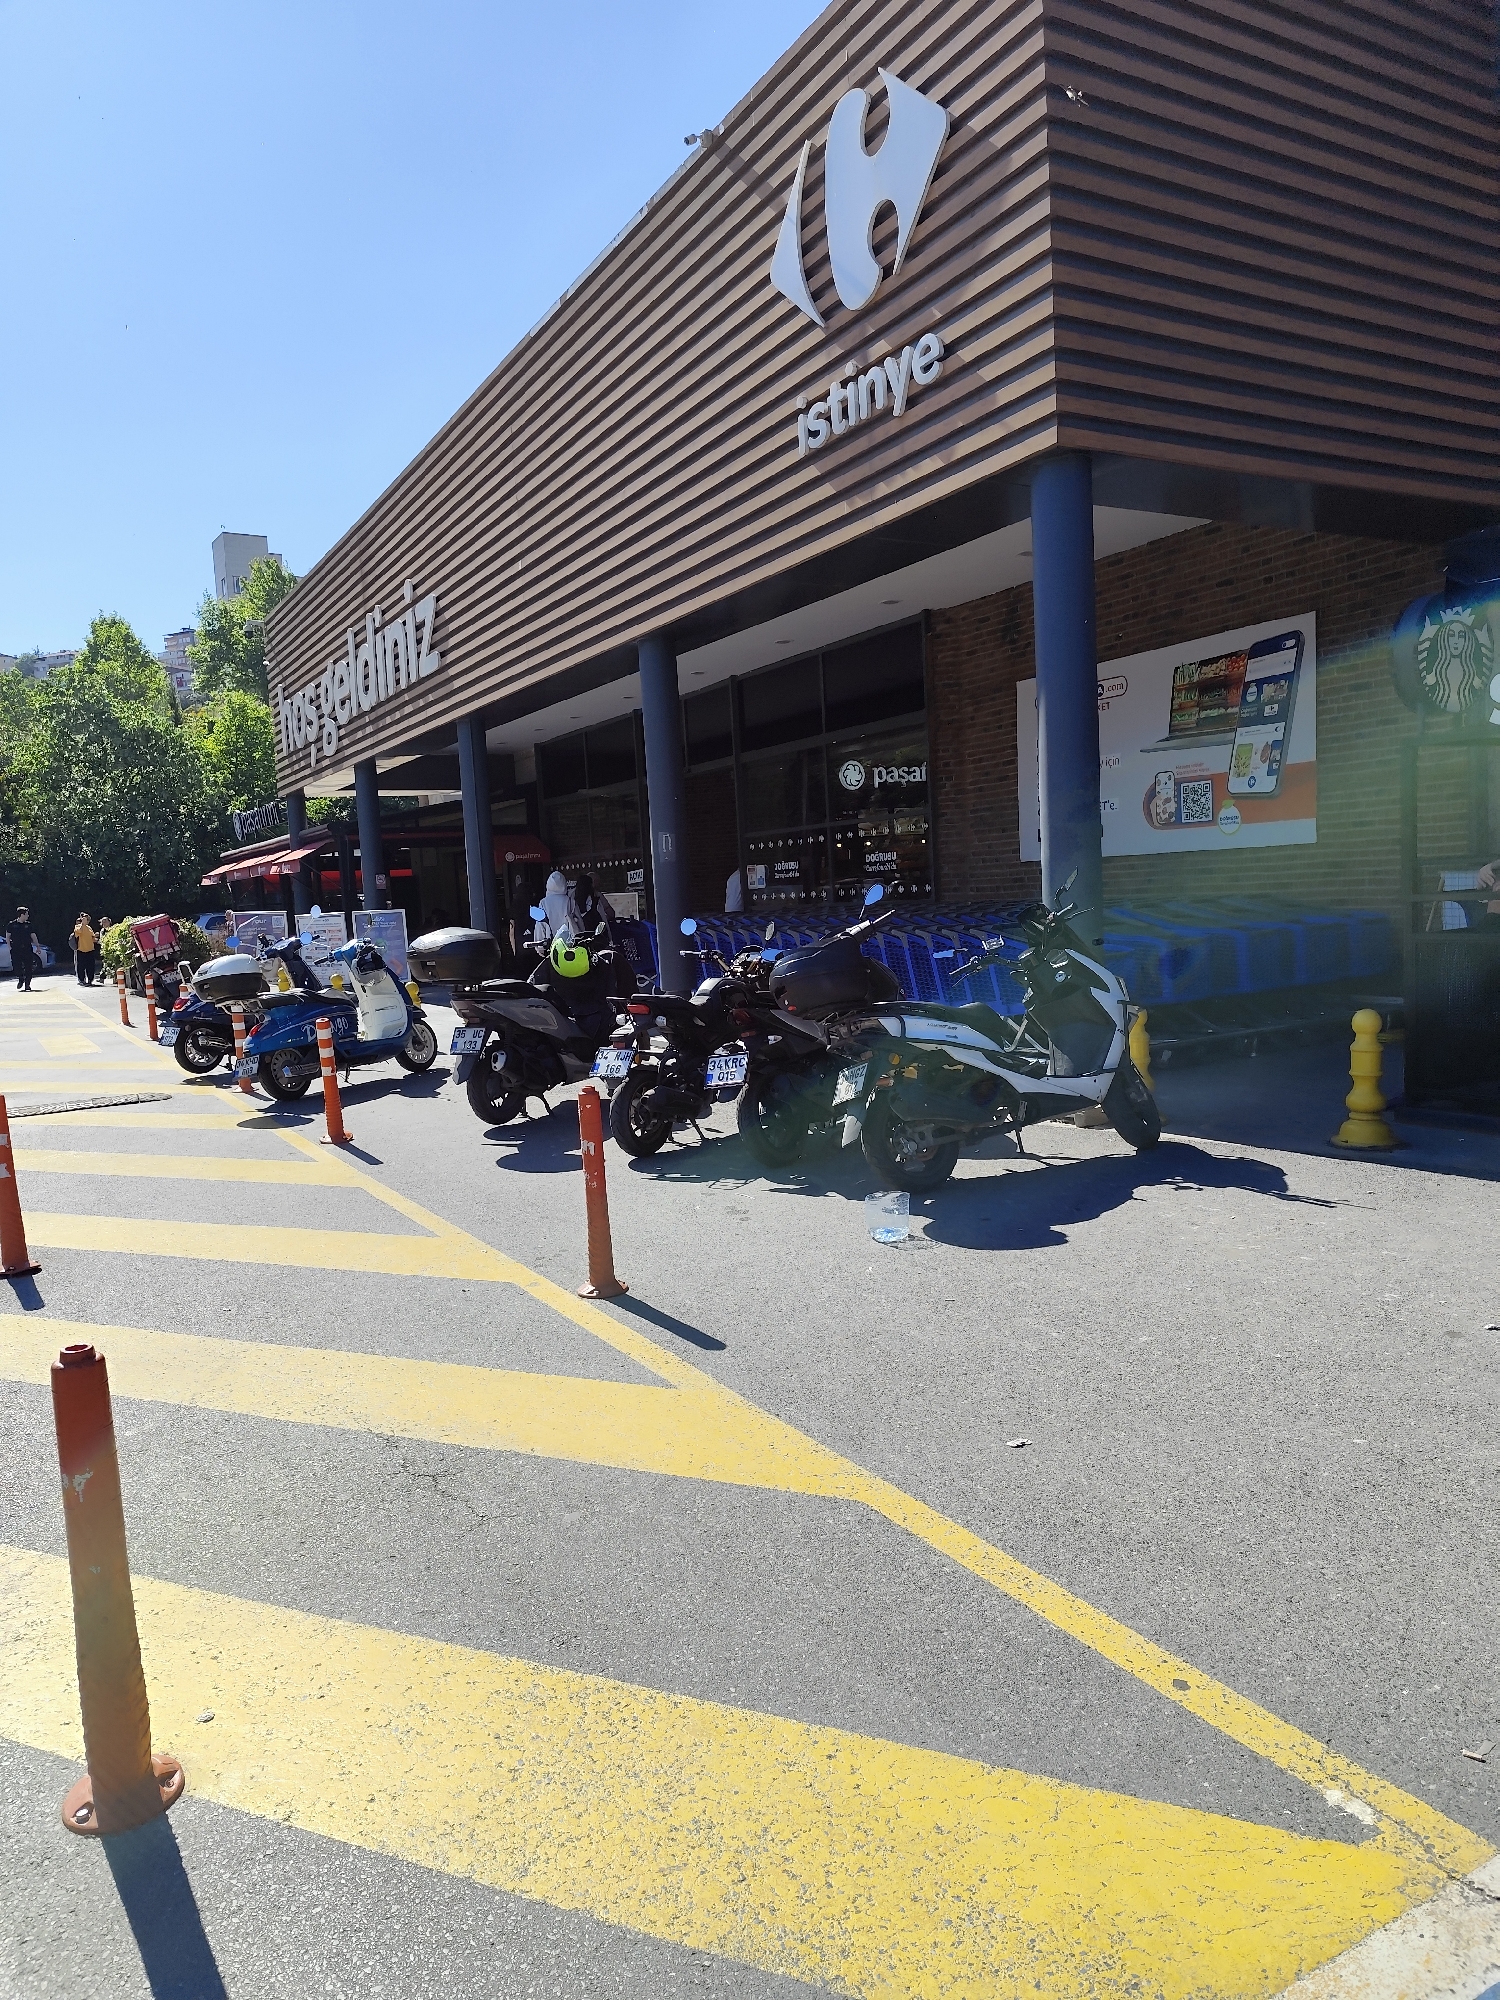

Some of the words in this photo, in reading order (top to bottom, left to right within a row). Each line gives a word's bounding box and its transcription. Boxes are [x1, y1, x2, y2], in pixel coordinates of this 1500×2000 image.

[796, 332, 944, 458] istinye
[455, 1029, 467, 1039] 35
[598, 1050, 609, 1060] 34
[717, 1070, 737, 1082] 015
